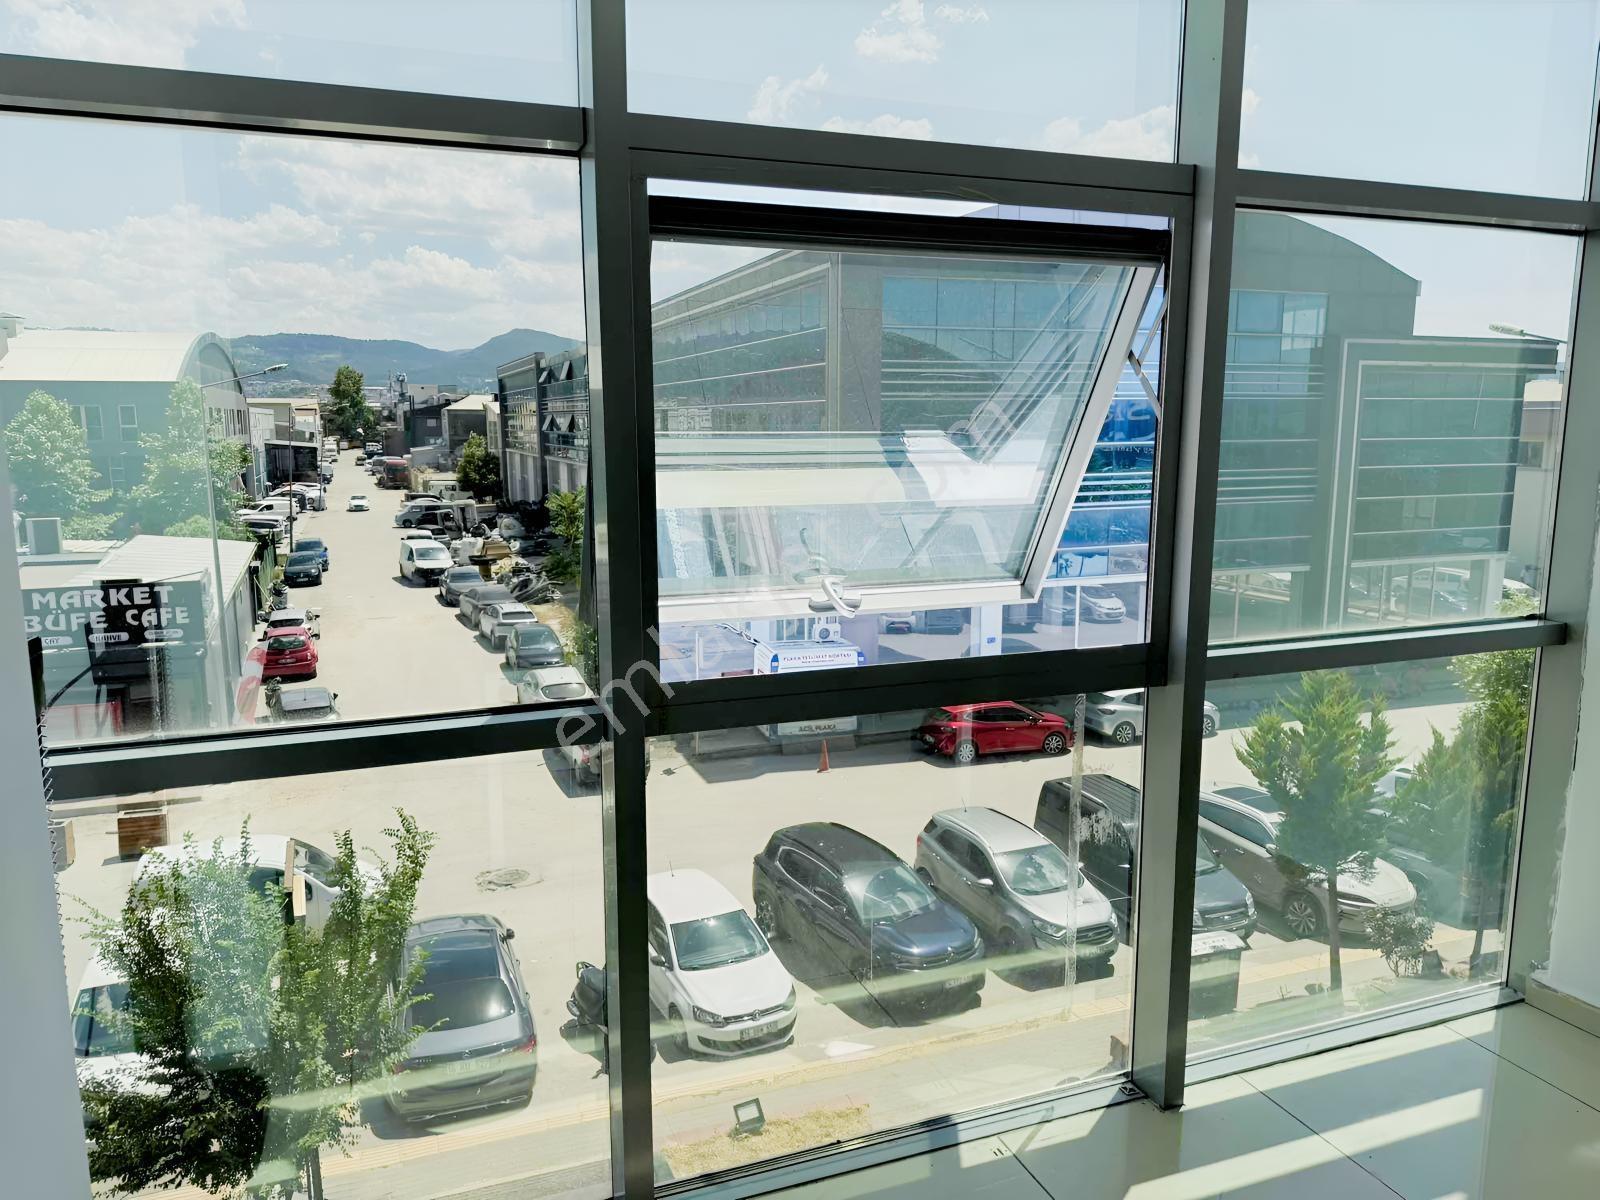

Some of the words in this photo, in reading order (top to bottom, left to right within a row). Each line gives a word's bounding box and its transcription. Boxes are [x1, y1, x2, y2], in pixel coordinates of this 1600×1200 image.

[31, 585, 174, 610] MARKET
[24, 610, 108, 633] BÜFE
[125, 606, 190, 628] CAFE
